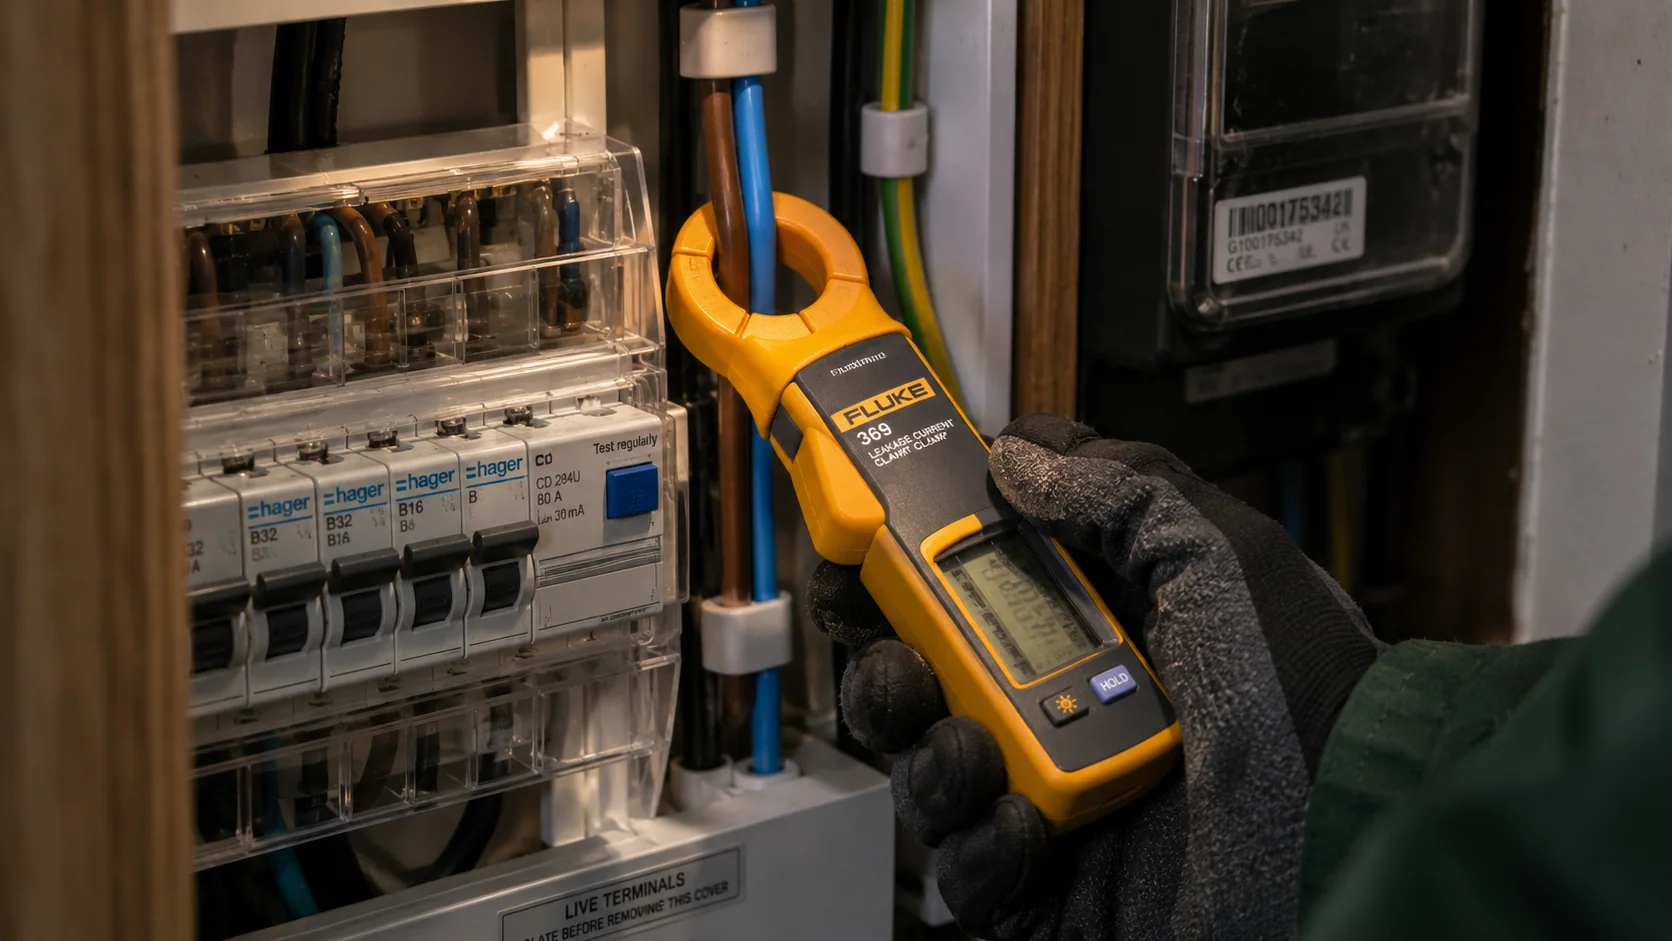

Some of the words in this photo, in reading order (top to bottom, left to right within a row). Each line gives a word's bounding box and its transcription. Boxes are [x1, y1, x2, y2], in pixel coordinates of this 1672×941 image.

[843, 382, 928, 426] FLUKE
[856, 422, 892, 445] 369
[593, 440, 614, 455] Test
[477, 457, 523, 477] hager
[408, 469, 455, 490] hager
[536, 475, 552, 490] CD
[336, 483, 385, 504] hager
[537, 492, 551, 506] 80
[554, 489, 563, 503] A
[260, 496, 310, 517] hager
[399, 500, 424, 517] B16
[326, 513, 352, 531] B32
[250, 527, 278, 545] B32
[186, 540, 204, 557] 32
[1100, 672, 1129, 692] HOLD
[565, 896, 598, 920] LIVE
[603, 872, 685, 908] TERMINALS
[562, 917, 604, 940] BEFORE
[607, 900, 664, 926] REMOVING
[668, 892, 691, 909] THIS
[694, 880, 729, 901] COVER
